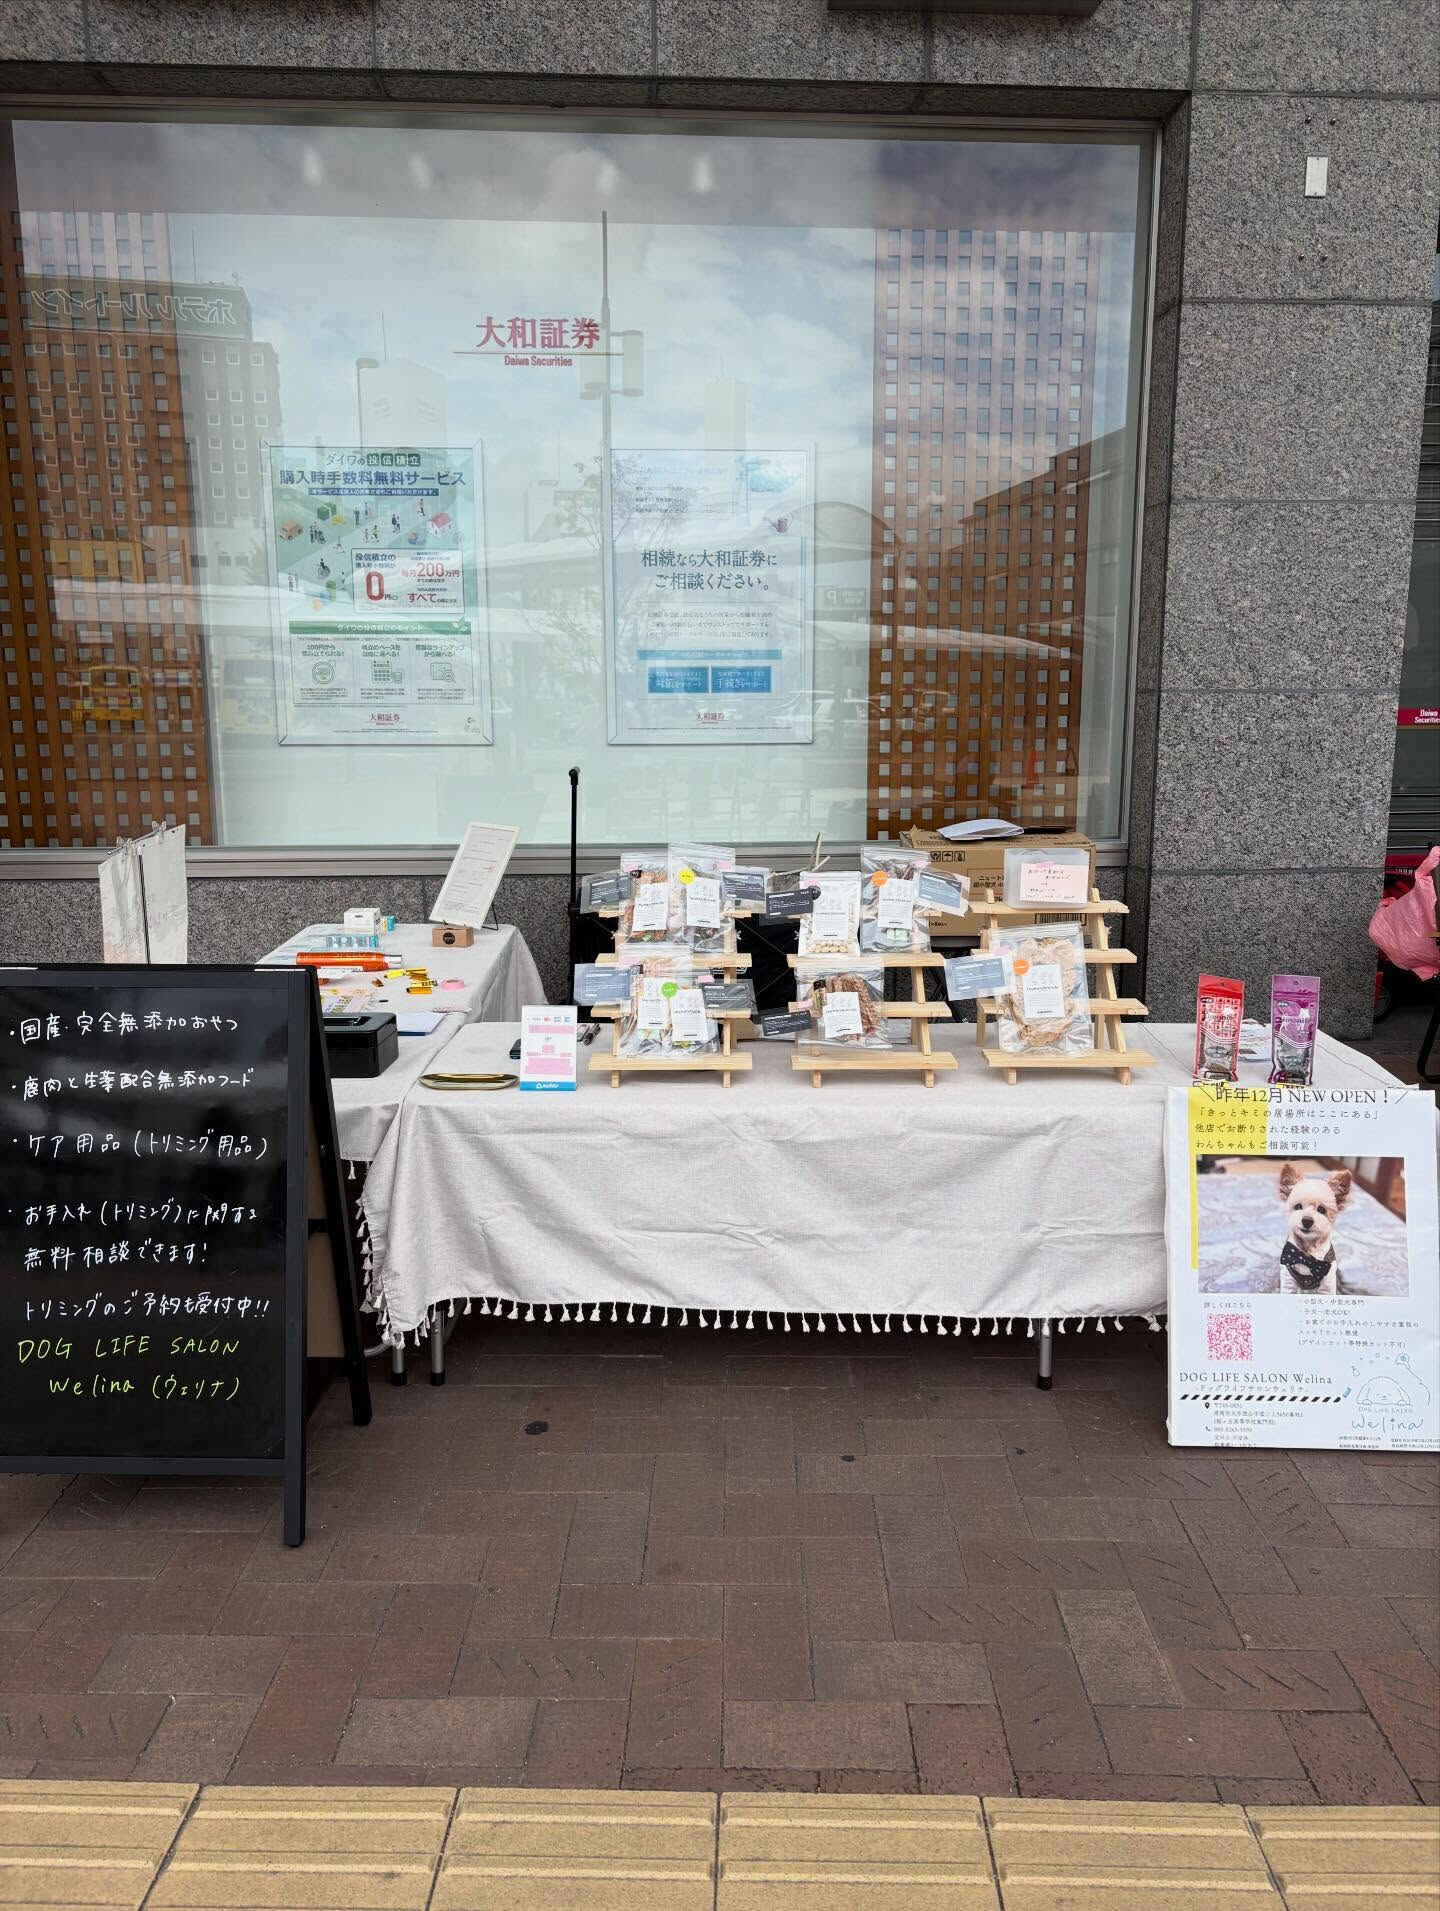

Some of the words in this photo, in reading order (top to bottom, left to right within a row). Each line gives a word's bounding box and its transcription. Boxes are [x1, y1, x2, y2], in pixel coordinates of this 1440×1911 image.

[476, 316, 600, 349] 大和証券
[504, 355, 530, 366] Daiwa
[531, 356, 573, 367] Securities
[326, 452, 420, 466] ダイワの投信積立
[279, 468, 466, 486] 購入時手数料無料サービス
[355, 553, 396, 561] 投信積立の
[641, 549, 778, 567] 相続なら大和証券に
[655, 572, 769, 590] ご相談ください。
[1216, 1088, 1282, 1103] 昨年12月
[1289, 1089, 1327, 1103] NEW
[1195, 1123, 1341, 1135] 他店でお断りされた経験のある
[18, 1337, 73, 1363] DOG
[95, 1335, 151, 1358] LIFE
[170, 1337, 240, 1355] SALON
[49, 1374, 135, 1397] Welina
[1179, 1373, 1208, 1382] DOG
[1213, 1373, 1240, 1382] LIFE
[1244, 1374, 1288, 1383] SALON
[1293, 1374, 1332, 1384] Welina
[1352, 1414, 1424, 1433] Welina
